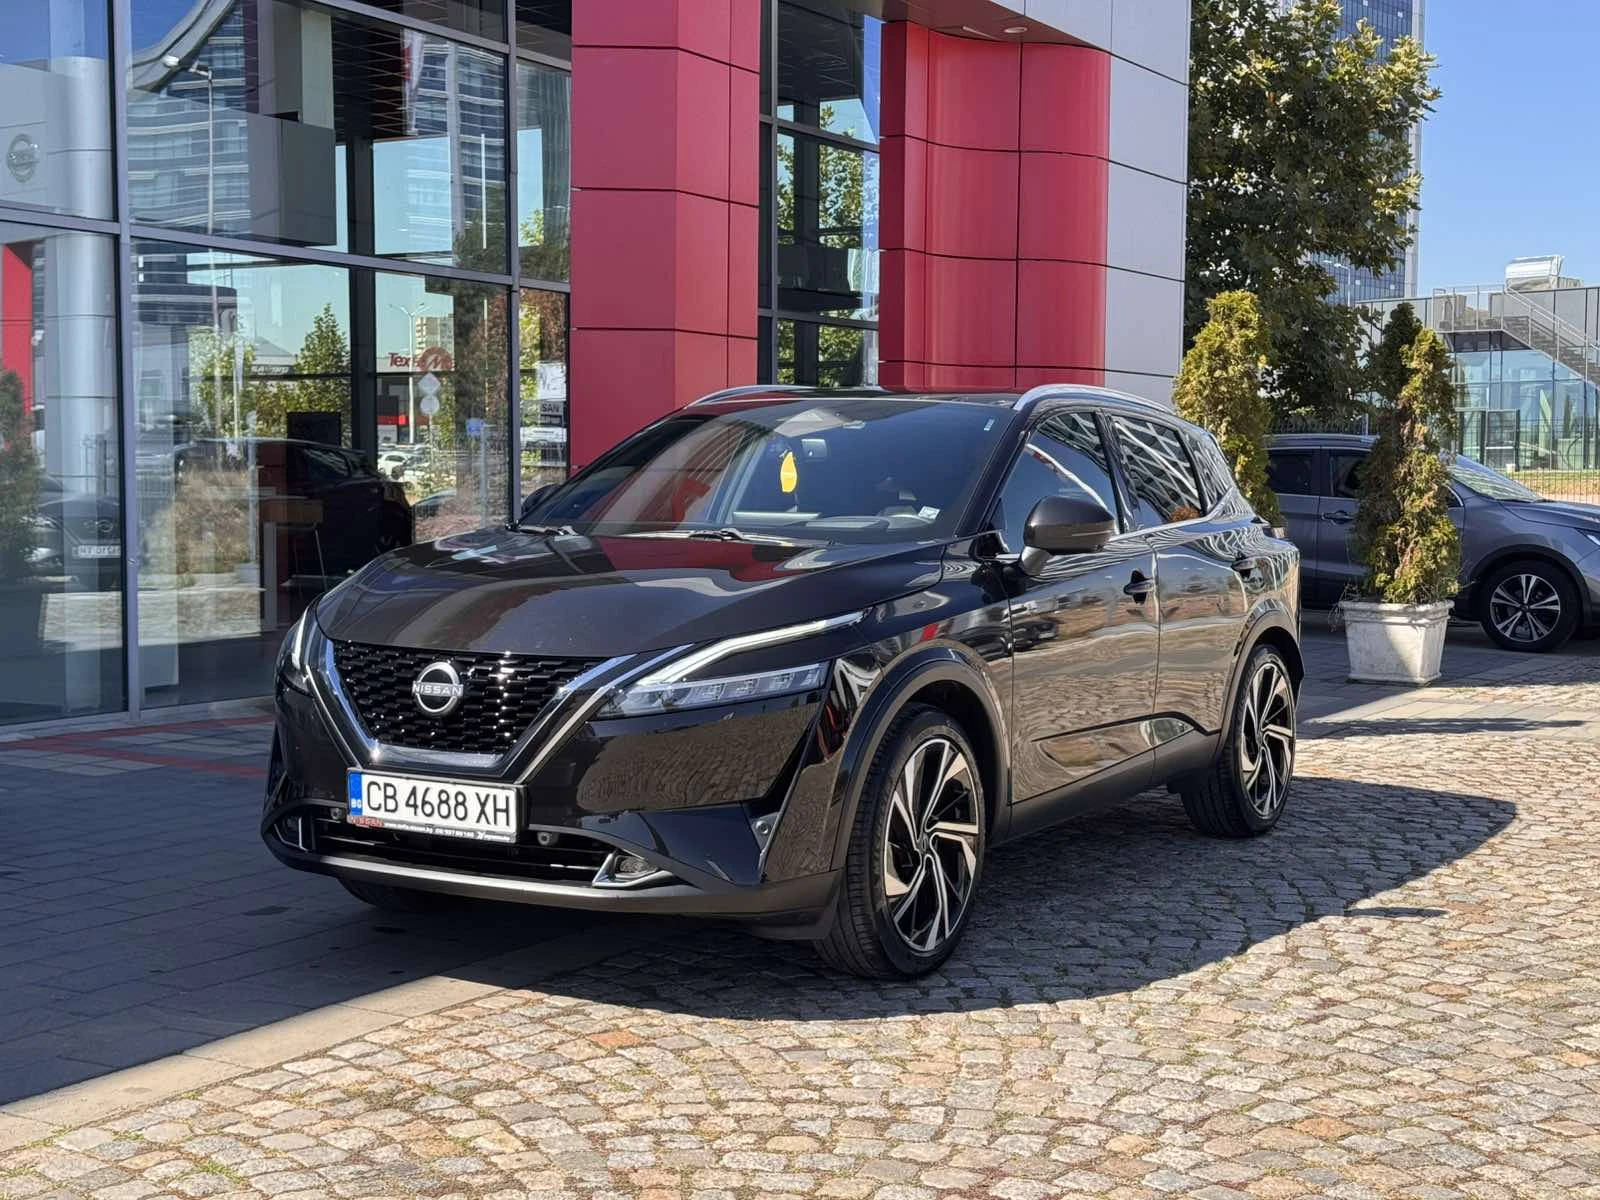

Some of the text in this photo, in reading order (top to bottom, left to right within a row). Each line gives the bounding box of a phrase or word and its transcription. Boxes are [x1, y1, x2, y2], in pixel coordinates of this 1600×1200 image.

[412, 680, 464, 697] NISSAN
[366, 781, 510, 826] CB 4688 XH
